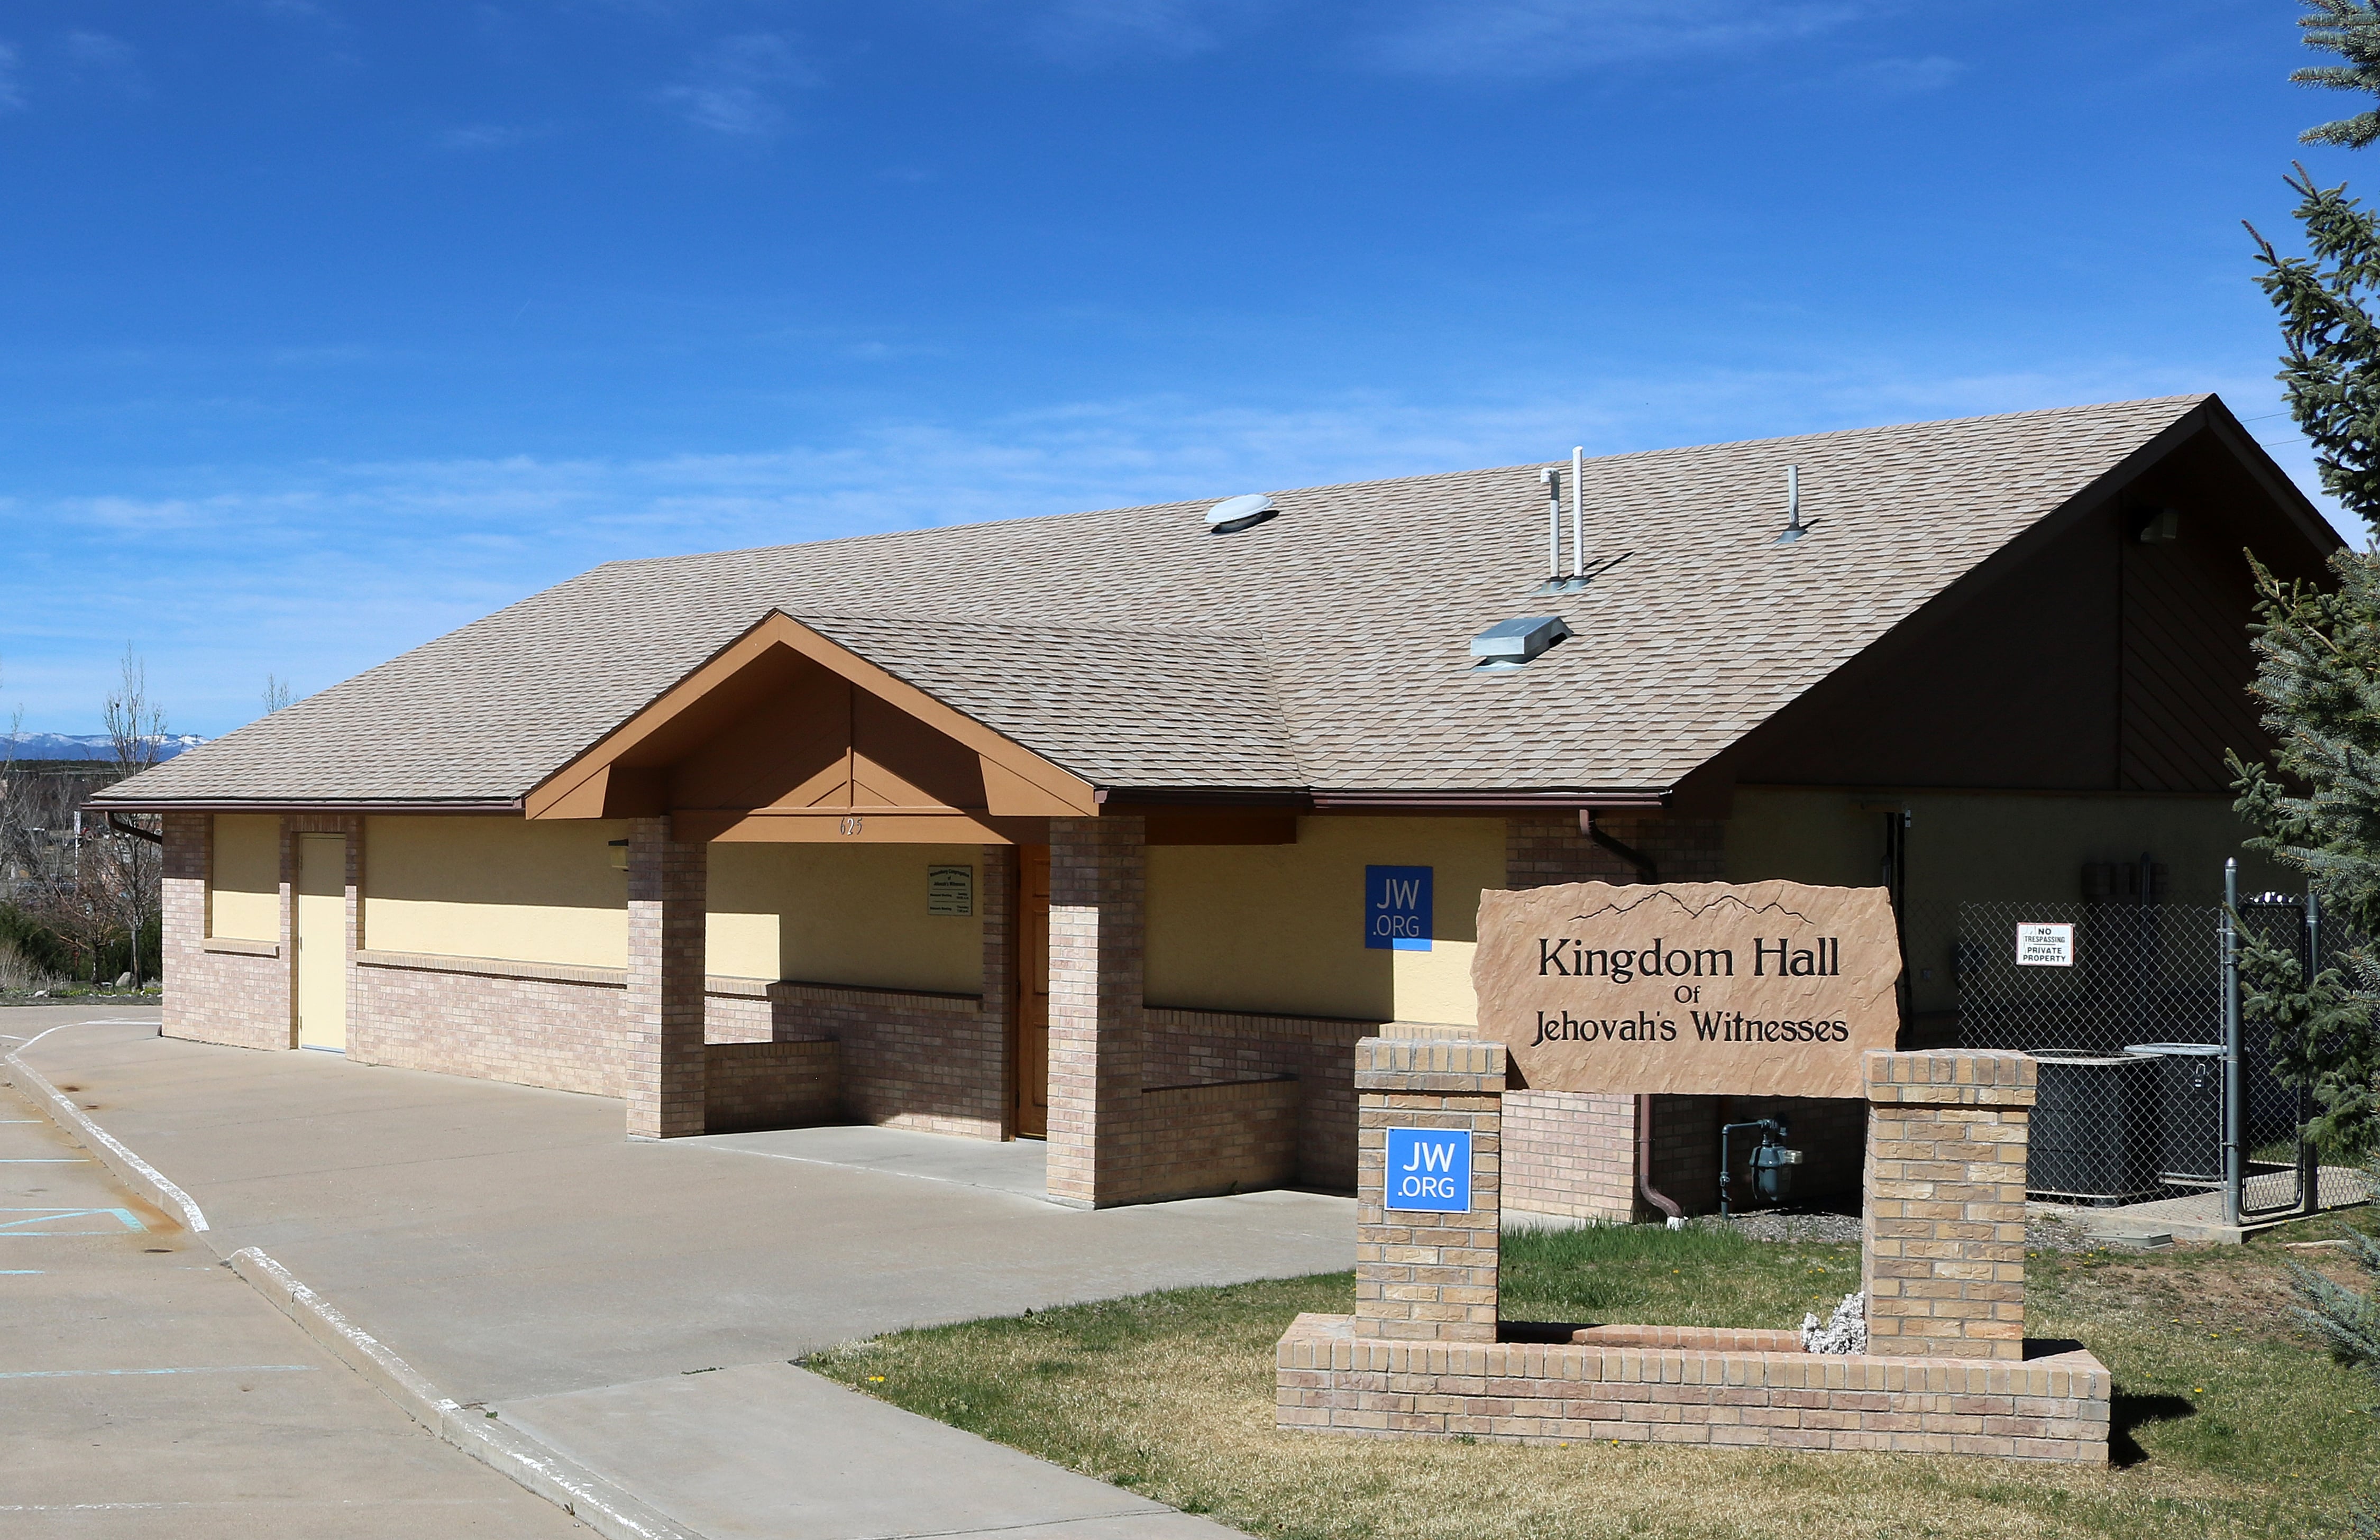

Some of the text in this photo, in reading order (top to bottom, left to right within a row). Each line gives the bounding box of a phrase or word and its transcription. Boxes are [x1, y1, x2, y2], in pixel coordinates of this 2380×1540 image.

[840, 817, 863, 836] 625
[1376, 878, 1420, 910] JW
[1373, 914, 1419, 937] .ORG
[1539, 938, 1840, 984] Kingdom Hall
[1674, 985, 1701, 1004] Of
[1531, 1011, 1849, 1047] Jehovah's Witnesses
[1403, 1142, 1456, 1172] JW
[1398, 1176, 1454, 1199] .ORG
